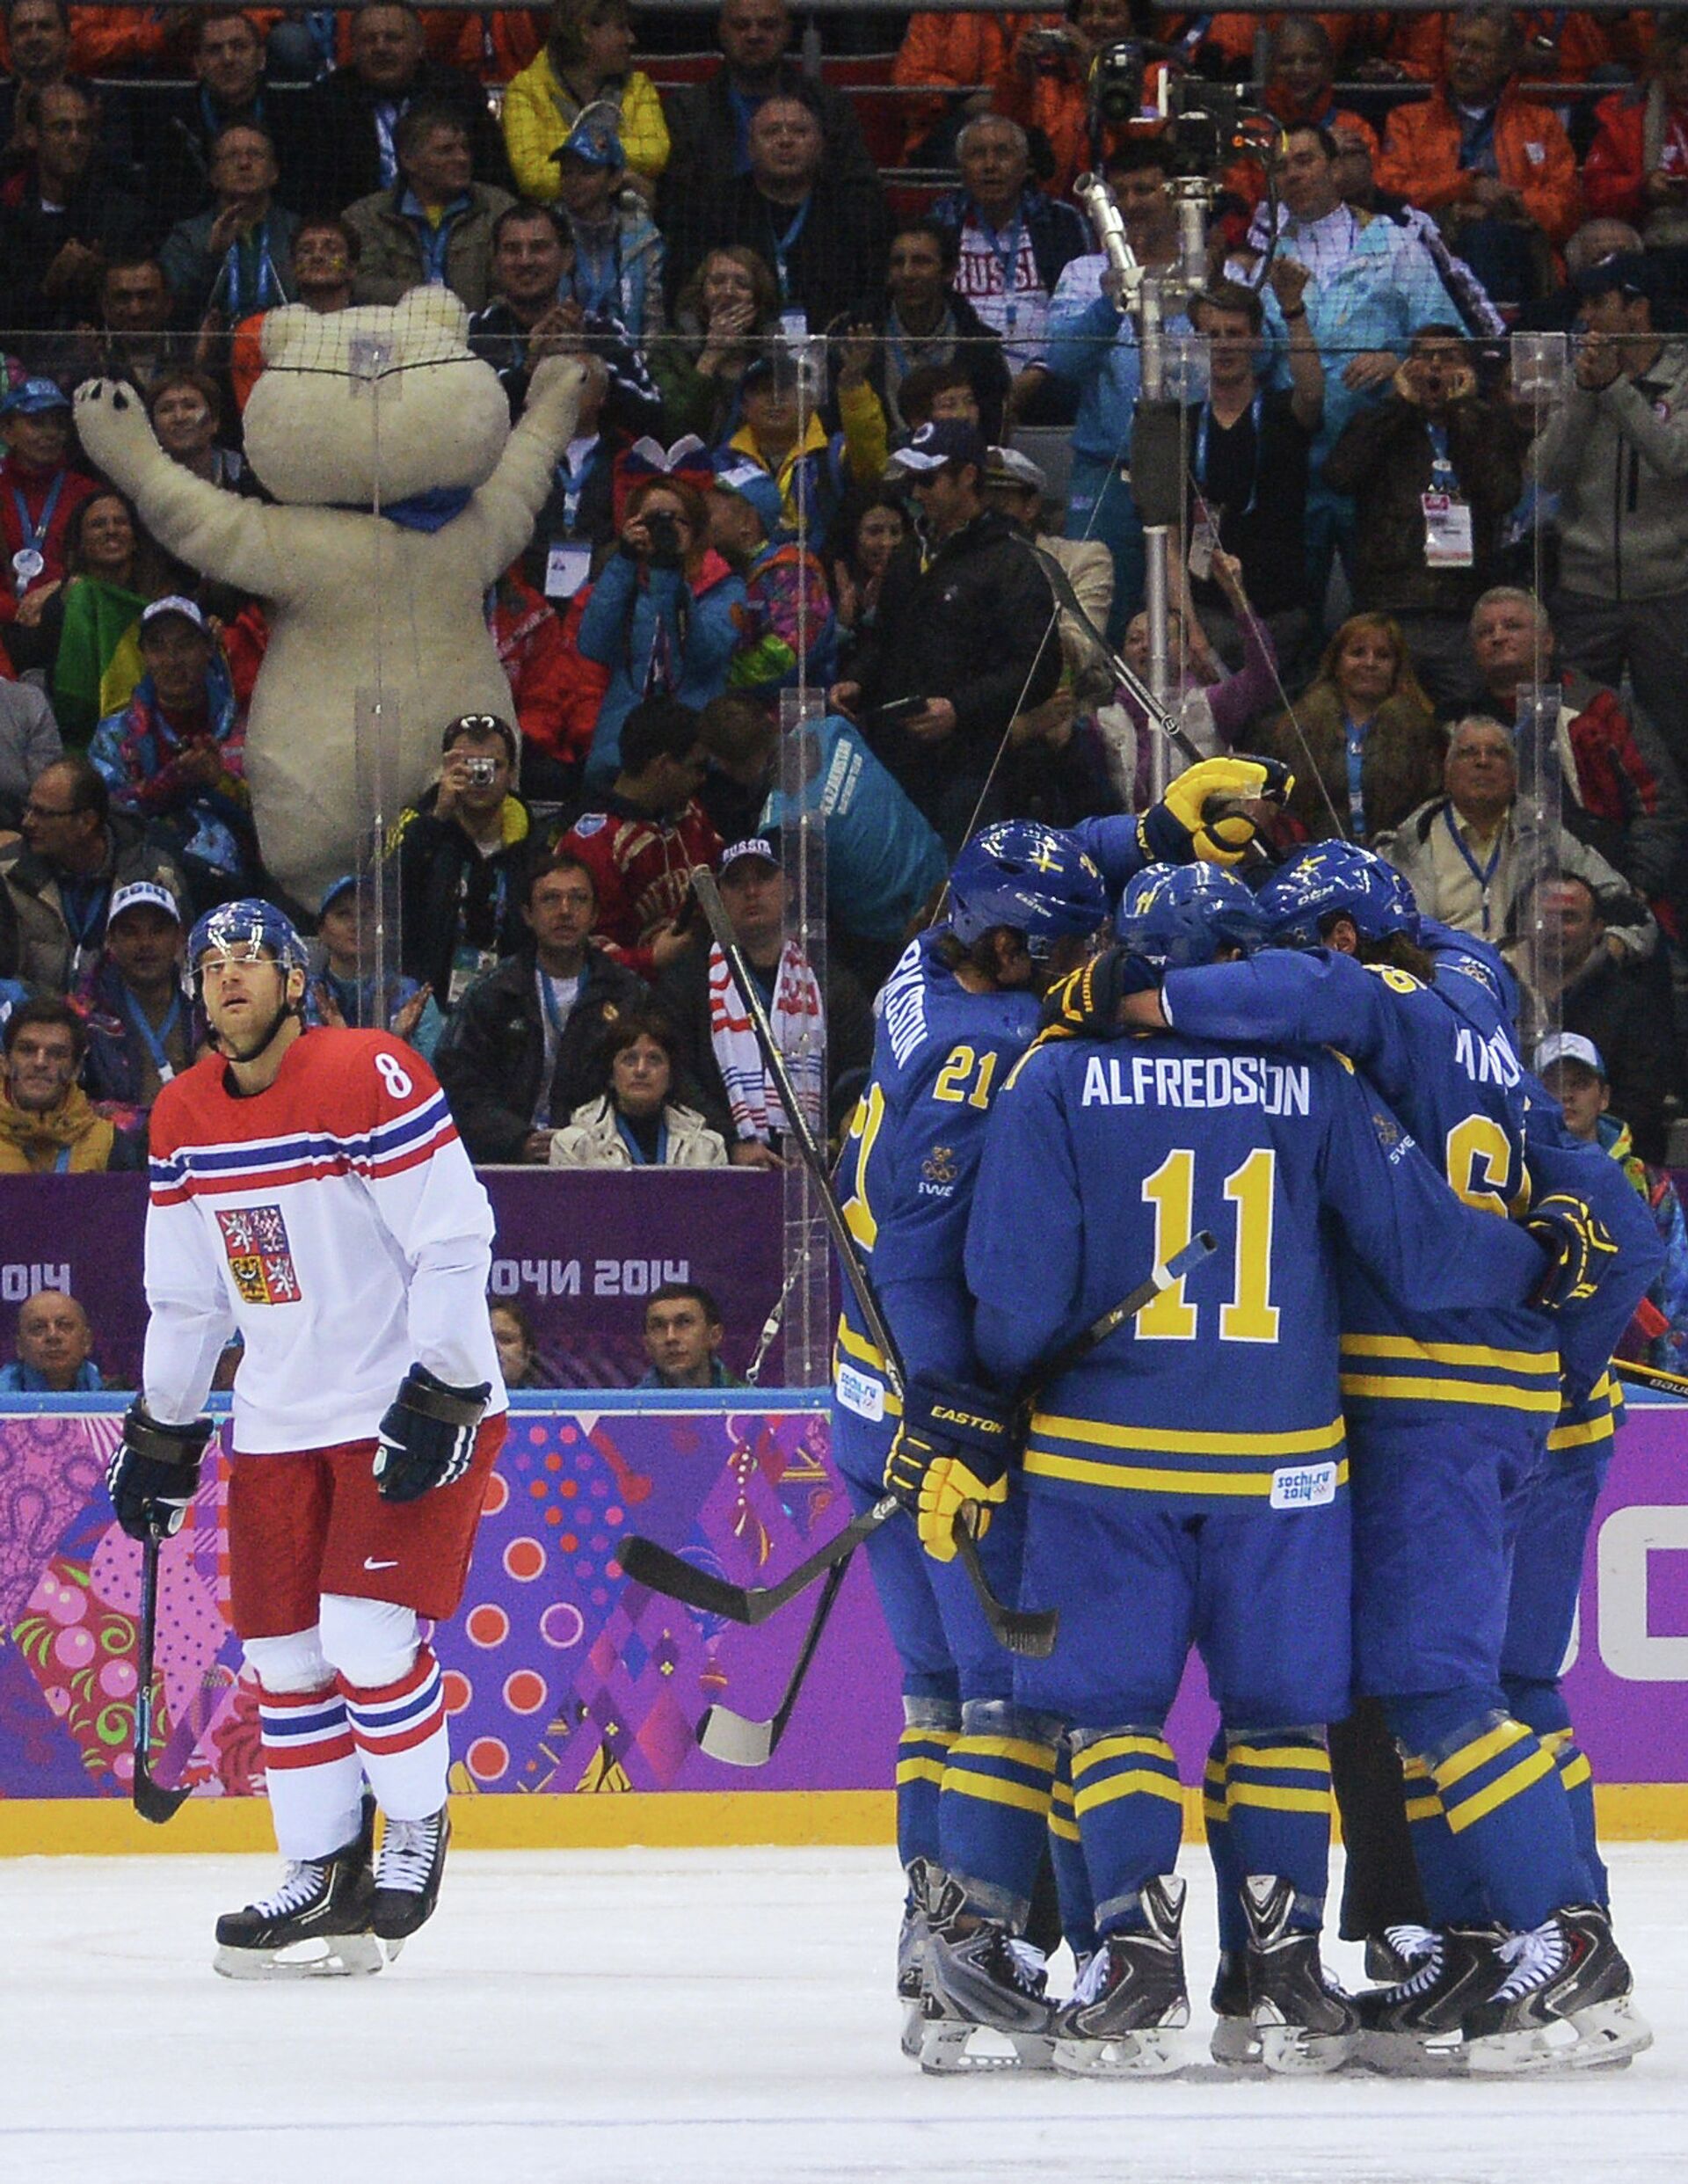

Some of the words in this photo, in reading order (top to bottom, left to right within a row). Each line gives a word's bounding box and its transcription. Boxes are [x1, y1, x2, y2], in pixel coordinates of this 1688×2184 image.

[375, 1052, 413, 1099] 8
[932, 1045, 998, 1110] 21
[1134, 1147, 1280, 1343] 11
[484, 1259, 581, 1295] ОЧИ
[593, 1259, 689, 1295] 2014
[930, 1404, 1007, 1434] EASTON
[1277, 1470, 1331, 1489] sochi.ru
[1284, 1486, 1313, 1501] 2014
